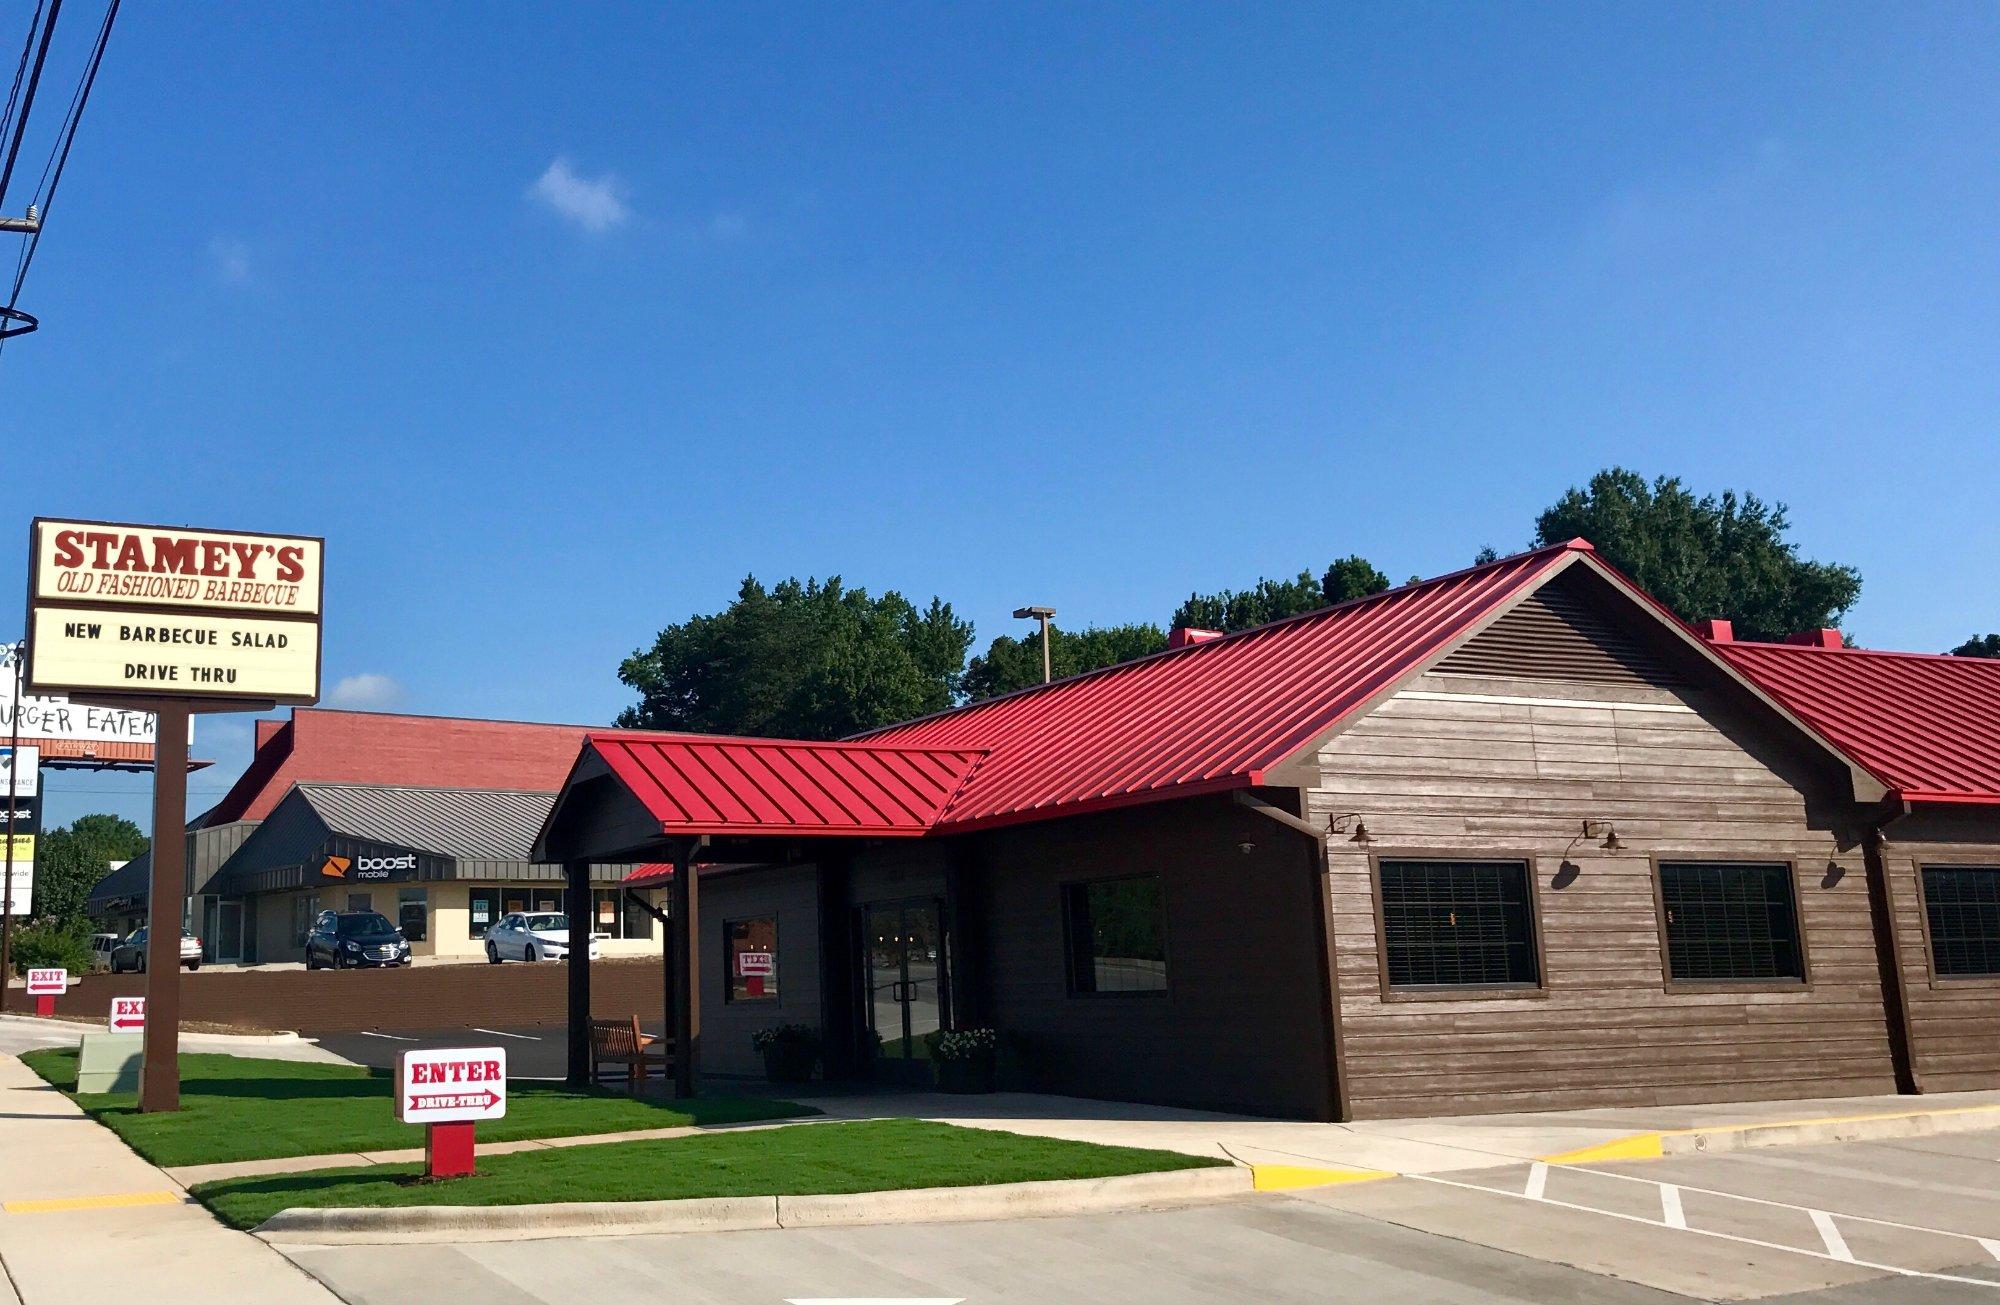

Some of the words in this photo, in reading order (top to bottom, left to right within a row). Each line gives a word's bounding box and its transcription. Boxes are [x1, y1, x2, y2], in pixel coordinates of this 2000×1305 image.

[54, 530, 305, 583] STAMEY'S
[57, 571, 94, 593] OLD
[96, 573, 199, 600] FASHIONED
[204, 580, 300, 606] BARBECUE
[65, 622, 102, 639] NEW
[119, 625, 218, 646] BARBECUE
[231, 631, 288, 649] SALAD
[124, 663, 178, 681] DRIVE
[190, 667, 237, 684] THRU
[357, 854, 416, 871] boost
[357, 870, 389, 879] mobile
[31, 970, 63, 982] EXIT
[116, 1001, 145, 1015] EXI
[411, 1060, 502, 1084] ENTER
[417, 1094, 492, 1109] DRIVE-THRU
